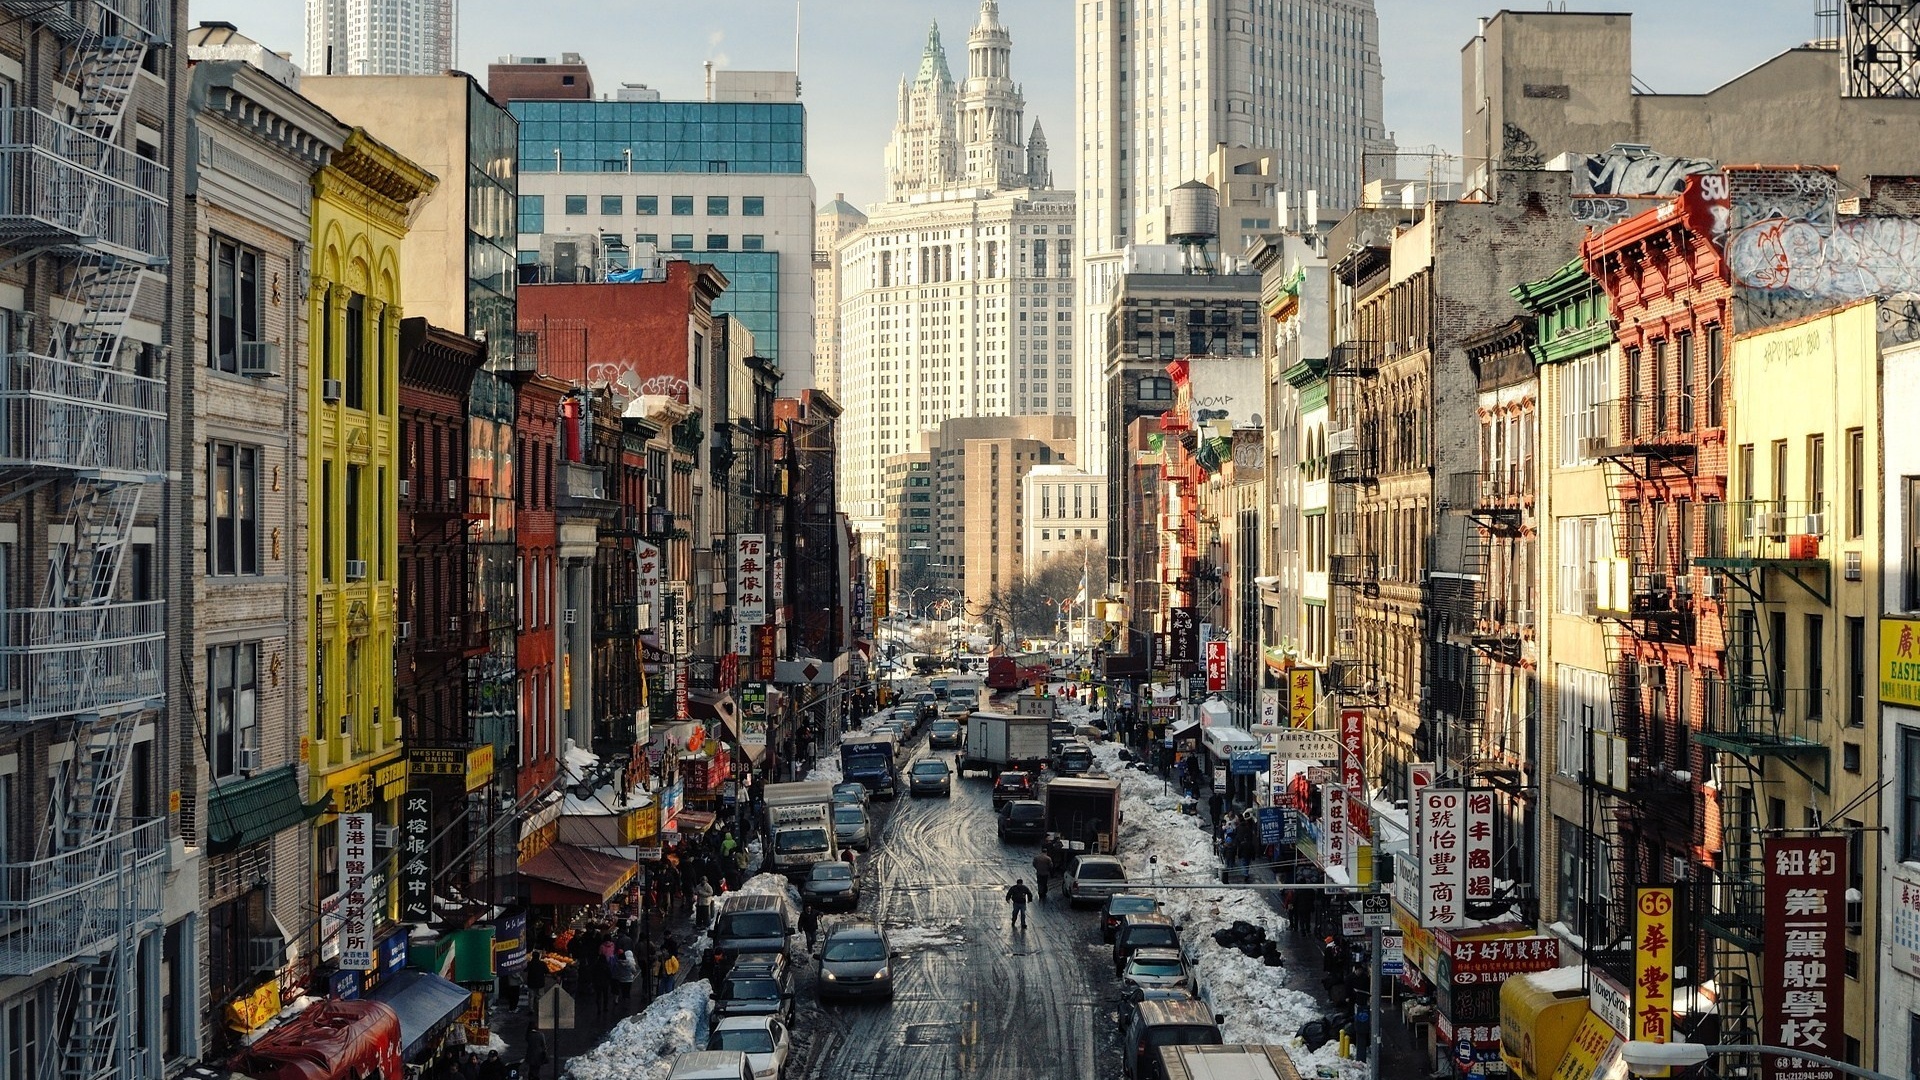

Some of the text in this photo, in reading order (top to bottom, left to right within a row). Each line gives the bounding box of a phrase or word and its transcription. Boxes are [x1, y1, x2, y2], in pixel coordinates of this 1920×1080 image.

[1194, 395, 1233, 407] WOMP
[739, 540, 763, 607] 福華傢俬
[1897, 624, 1920, 659] 廣
[1344, 716, 1360, 789] 農家飯莊
[1330, 790, 1344, 866] 興旺旺商場
[407, 798, 428, 915] 欣榕服務中心
[1775, 850, 1835, 876] 紐約
[1641, 893, 1669, 914] 66
[1454, 940, 1558, 962] 好好駕駛學校
[1456, 973, 1474, 982] 62
[1481, 973, 1491, 982] TEL
[1493, 973, 1498, 982] &
[1781, 888, 1827, 1049] 第一駕駛學校
[1777, 1059, 1788, 1067] 68
